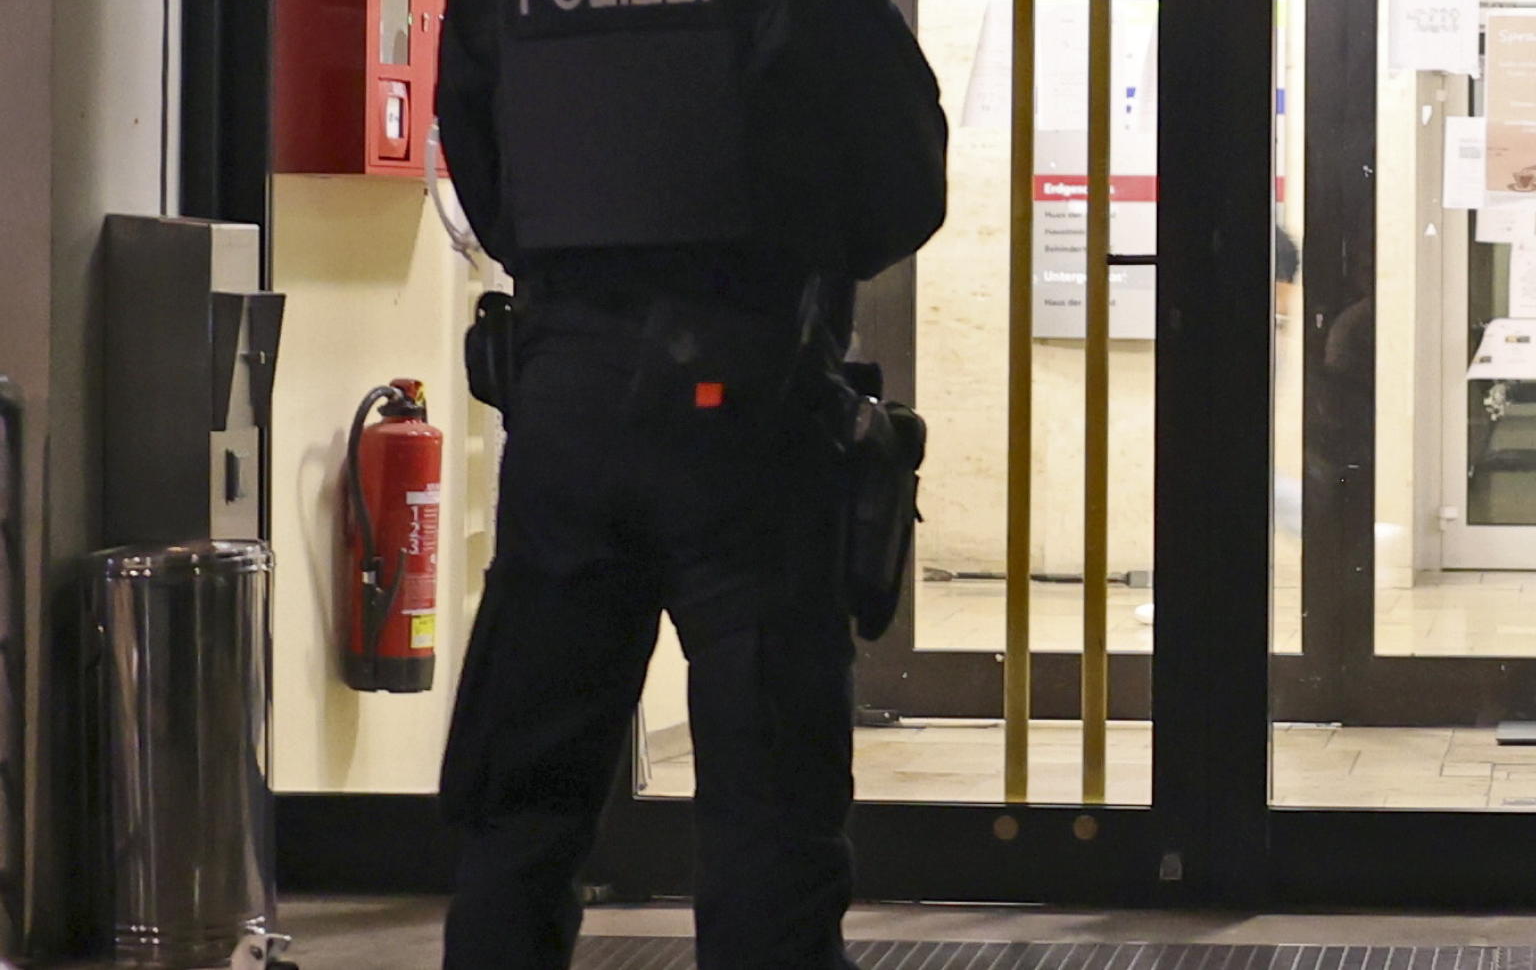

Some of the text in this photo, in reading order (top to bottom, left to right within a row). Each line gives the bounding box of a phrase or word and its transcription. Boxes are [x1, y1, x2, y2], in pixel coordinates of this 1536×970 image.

[410, 506, 419, 521] 1
[409, 522, 420, 537] 2
[408, 539, 420, 555] 3
